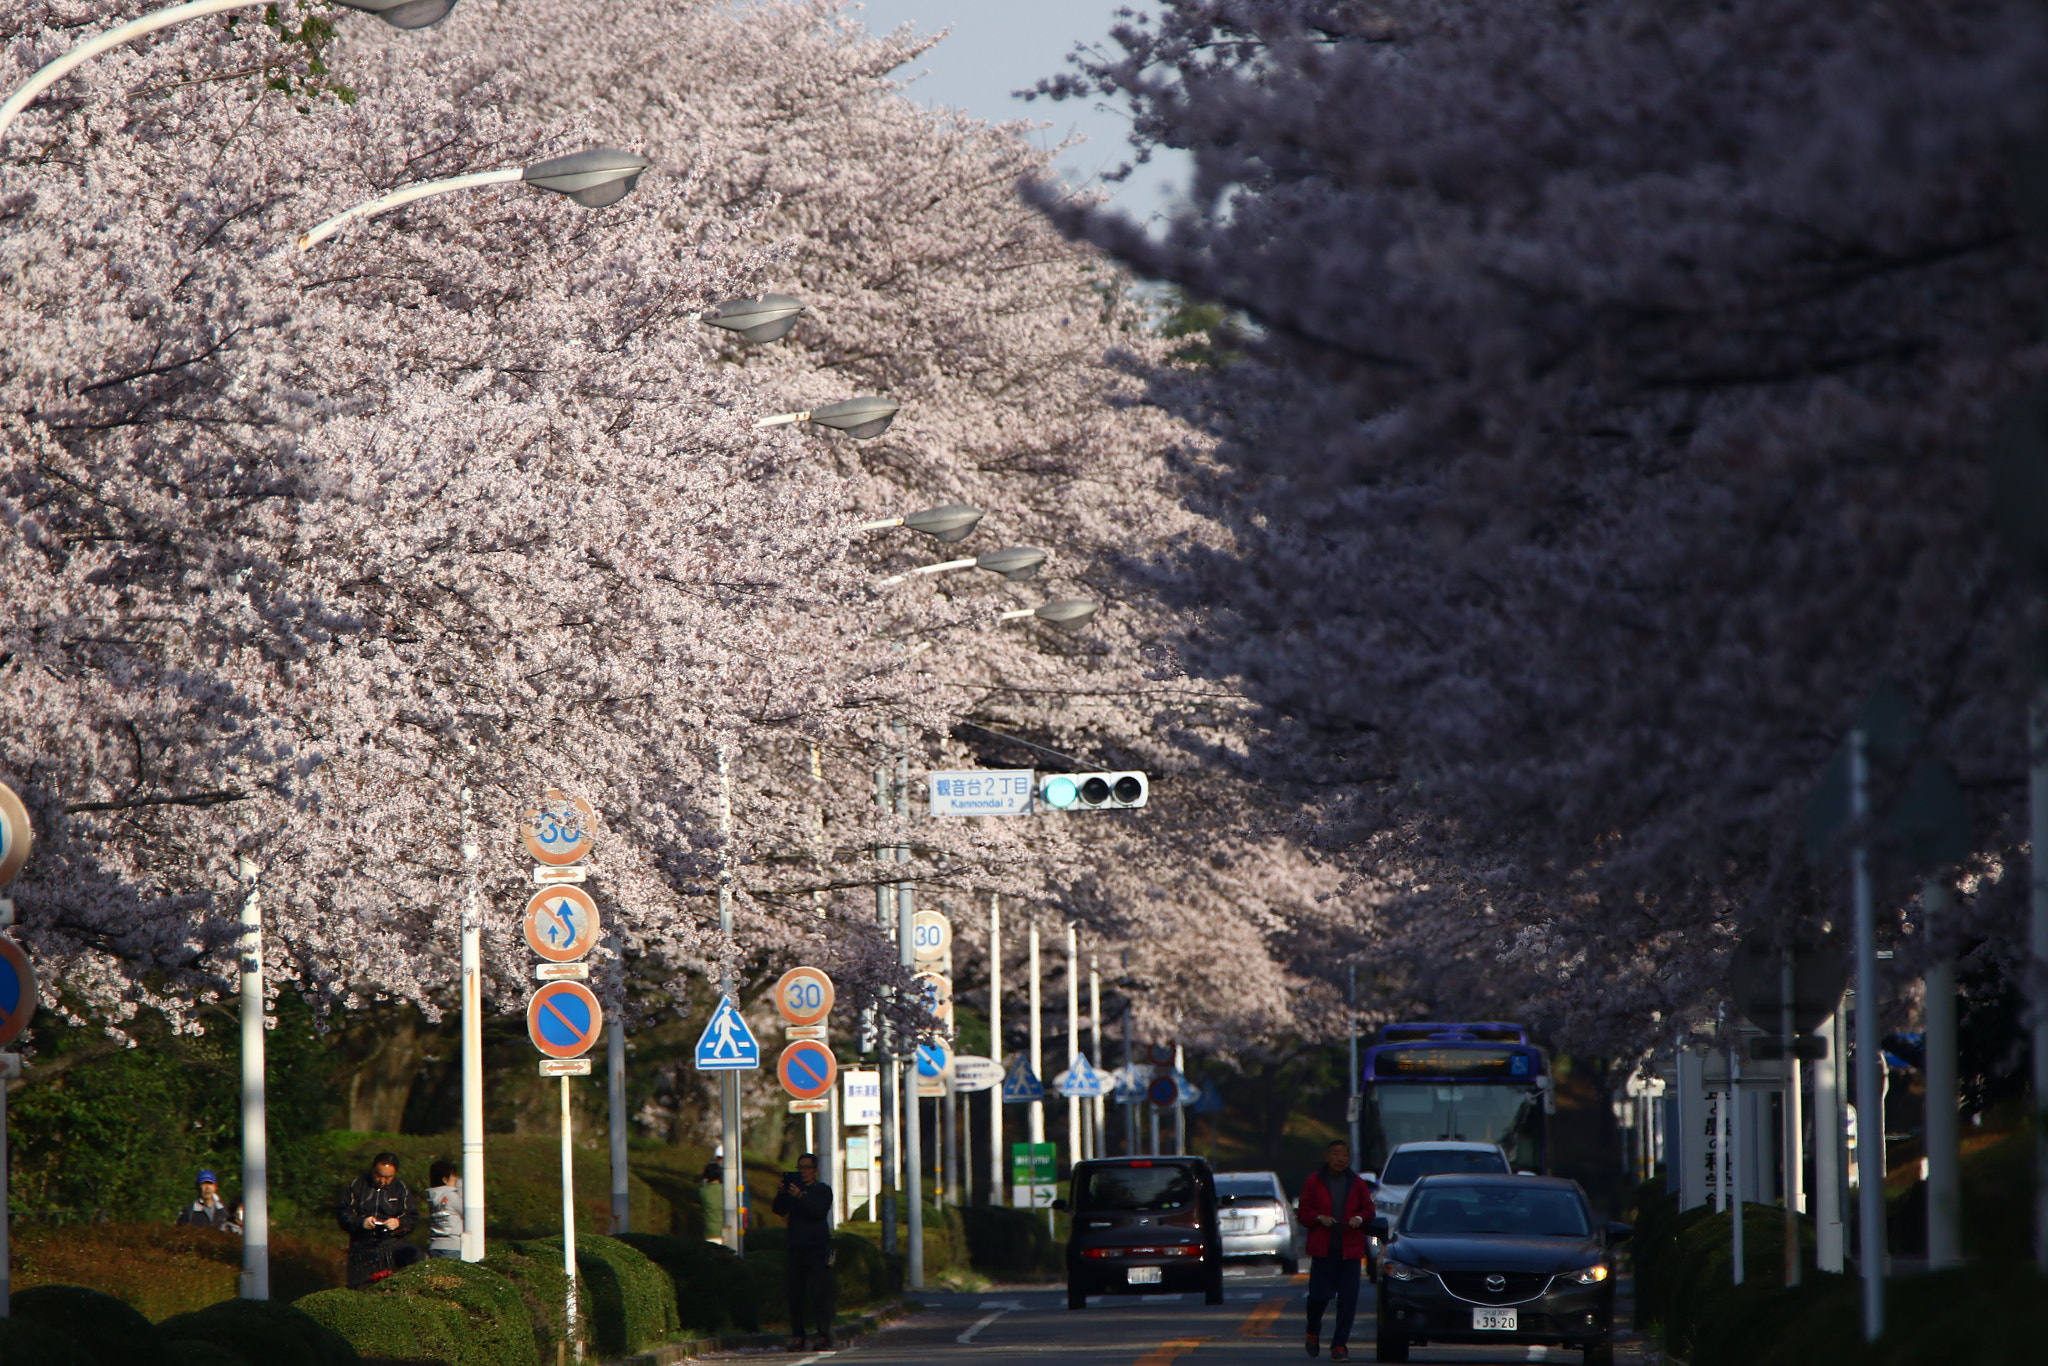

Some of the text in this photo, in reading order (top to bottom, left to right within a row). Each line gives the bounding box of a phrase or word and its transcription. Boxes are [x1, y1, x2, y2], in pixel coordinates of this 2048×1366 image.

[936, 776, 1029, 797] 観音台2丁目
[951, 797, 1014, 808] Kannondai 2
[540, 812, 580, 844] 30
[915, 925, 940, 946] 30
[789, 983, 821, 1010] 30
